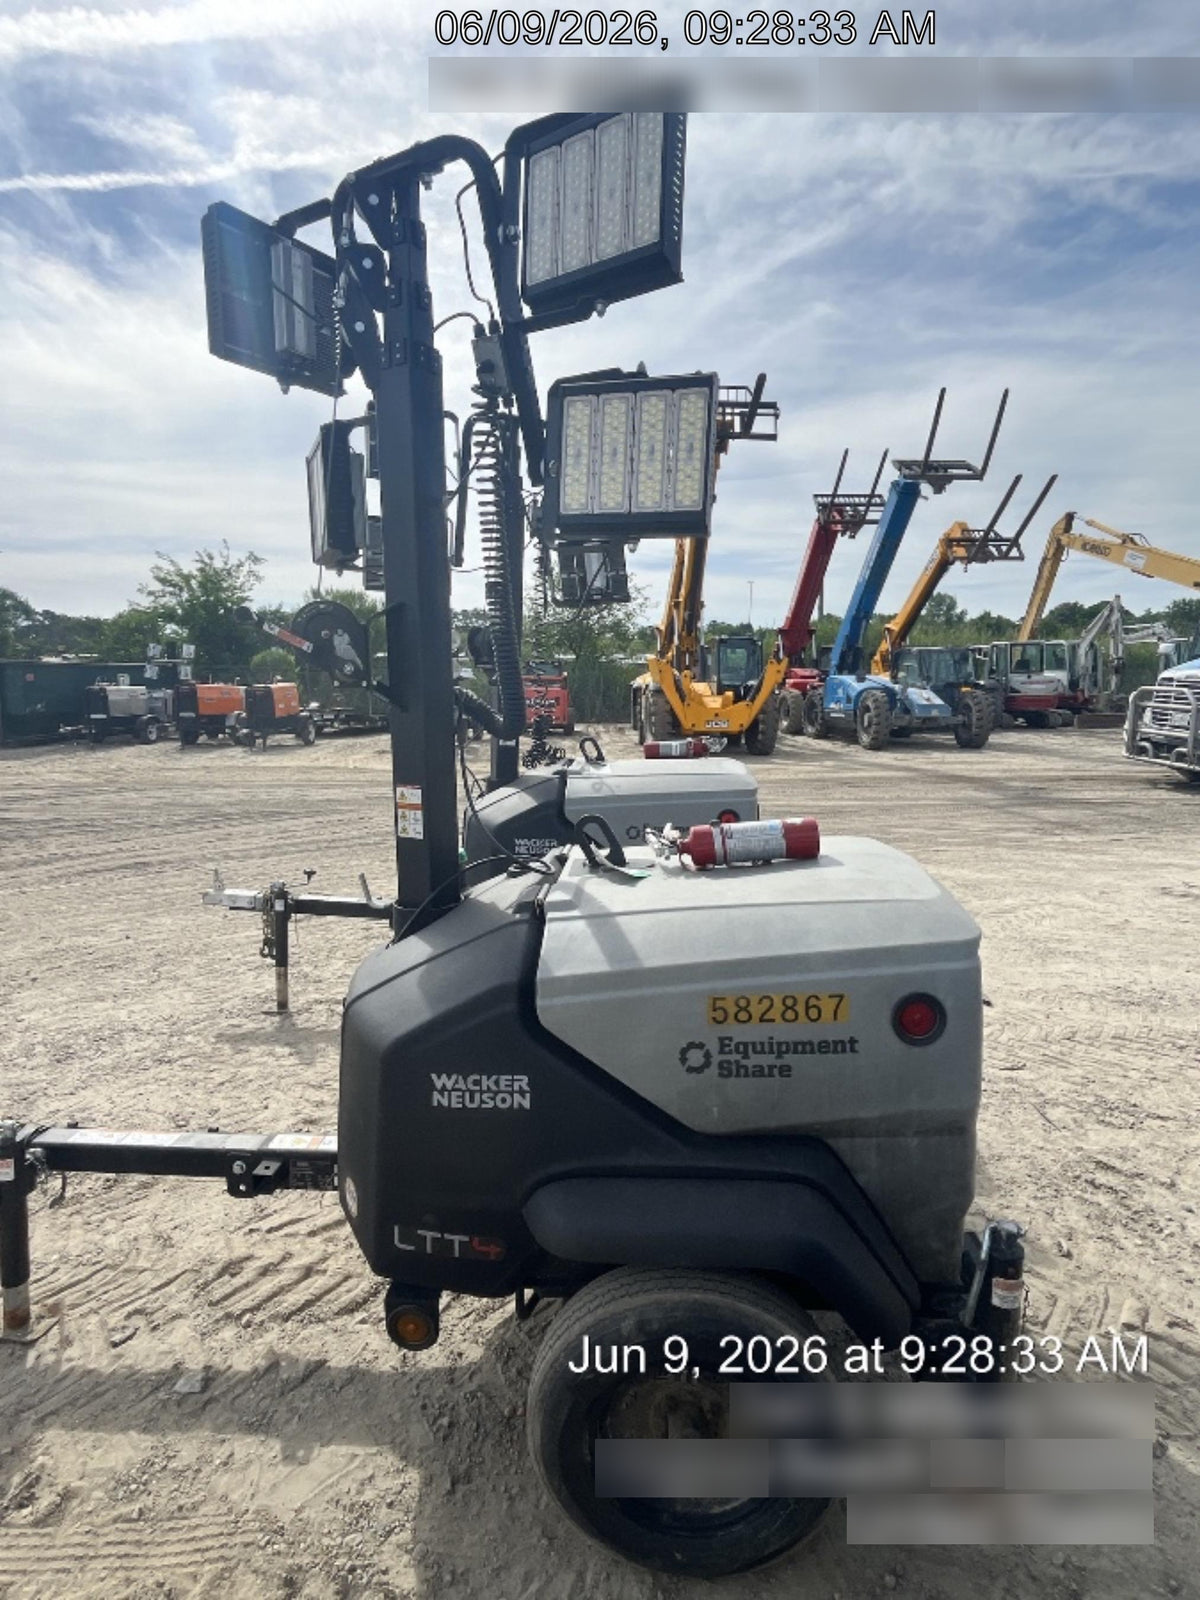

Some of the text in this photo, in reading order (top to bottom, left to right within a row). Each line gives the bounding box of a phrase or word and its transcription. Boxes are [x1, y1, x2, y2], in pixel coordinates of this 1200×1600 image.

[711, 993, 846, 1025] 582867
[717, 1036, 860, 1060] Equipment
[717, 1059, 793, 1079] Share
[430, 1072, 531, 1091] WACKER
[431, 1091, 531, 1110] NEUSON
